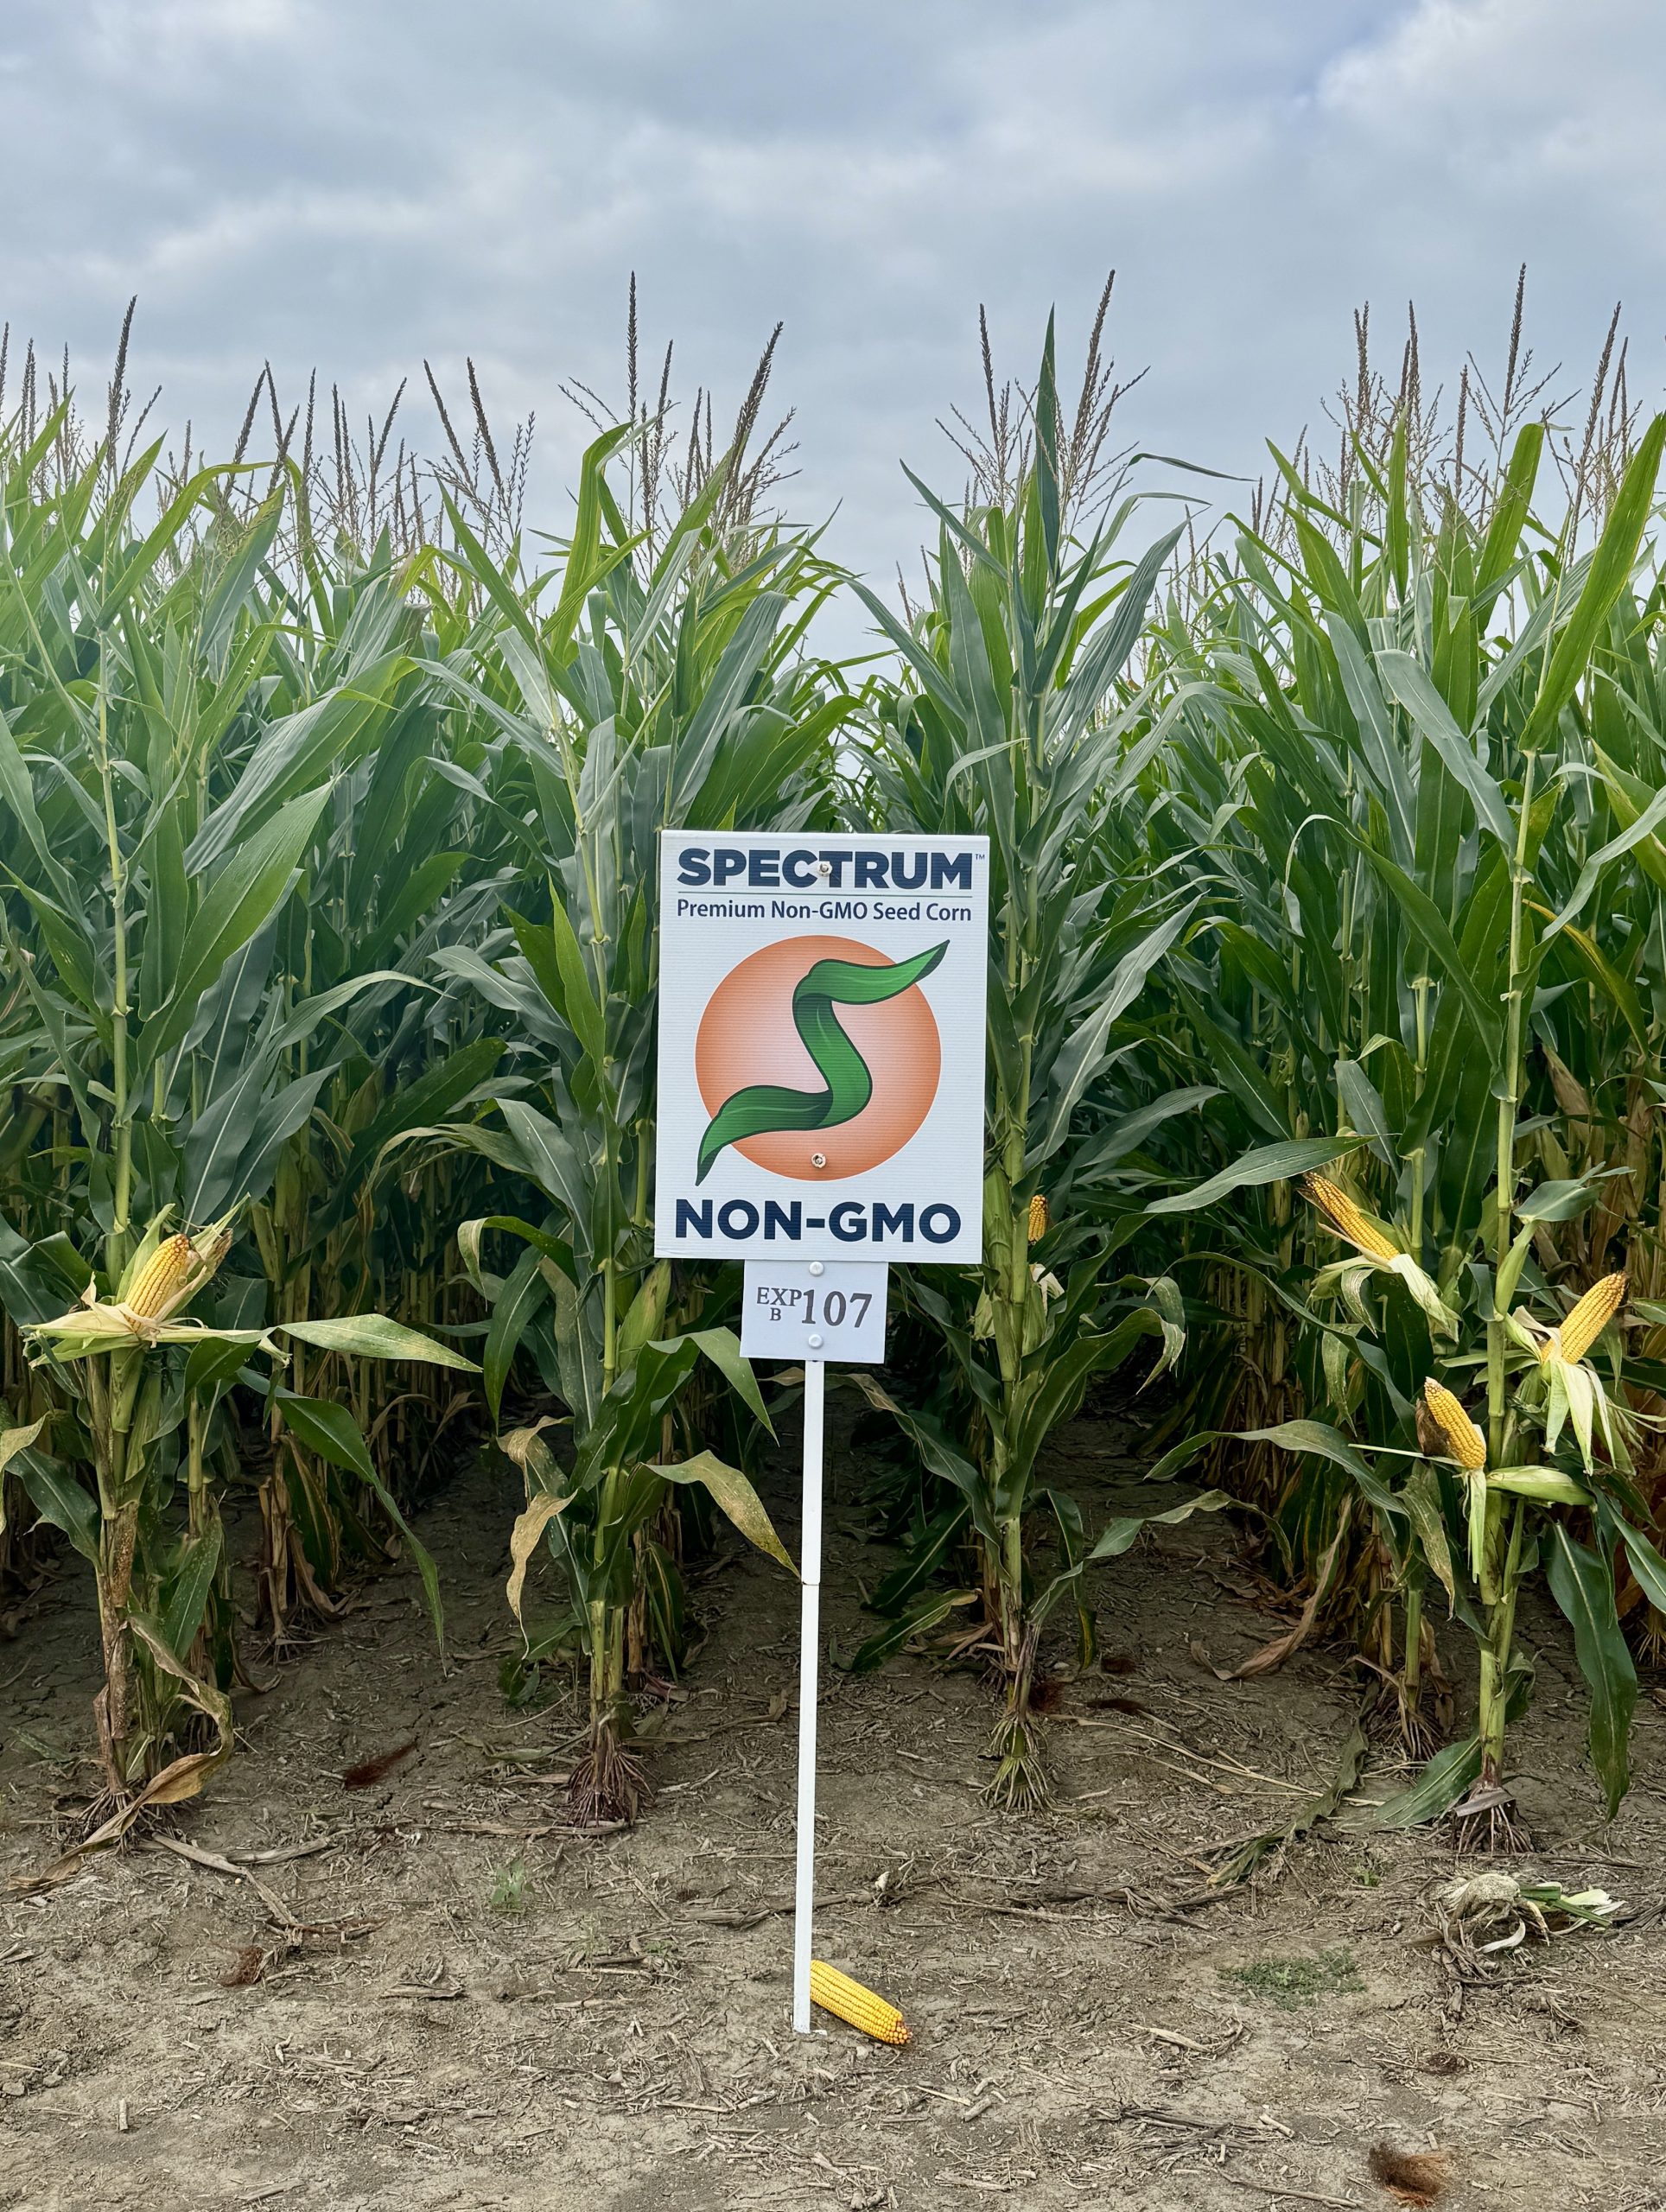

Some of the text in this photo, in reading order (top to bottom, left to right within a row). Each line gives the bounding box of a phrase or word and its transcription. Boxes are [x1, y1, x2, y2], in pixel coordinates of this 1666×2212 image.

[677, 848, 973, 890] SPECTRUM
[677, 899, 972, 921] Premium Non-GMO Seed Corn
[675, 1198, 962, 1244] NON-GMO
[756, 1287, 873, 1328] EXP 107
[769, 1306, 782, 1321] B
